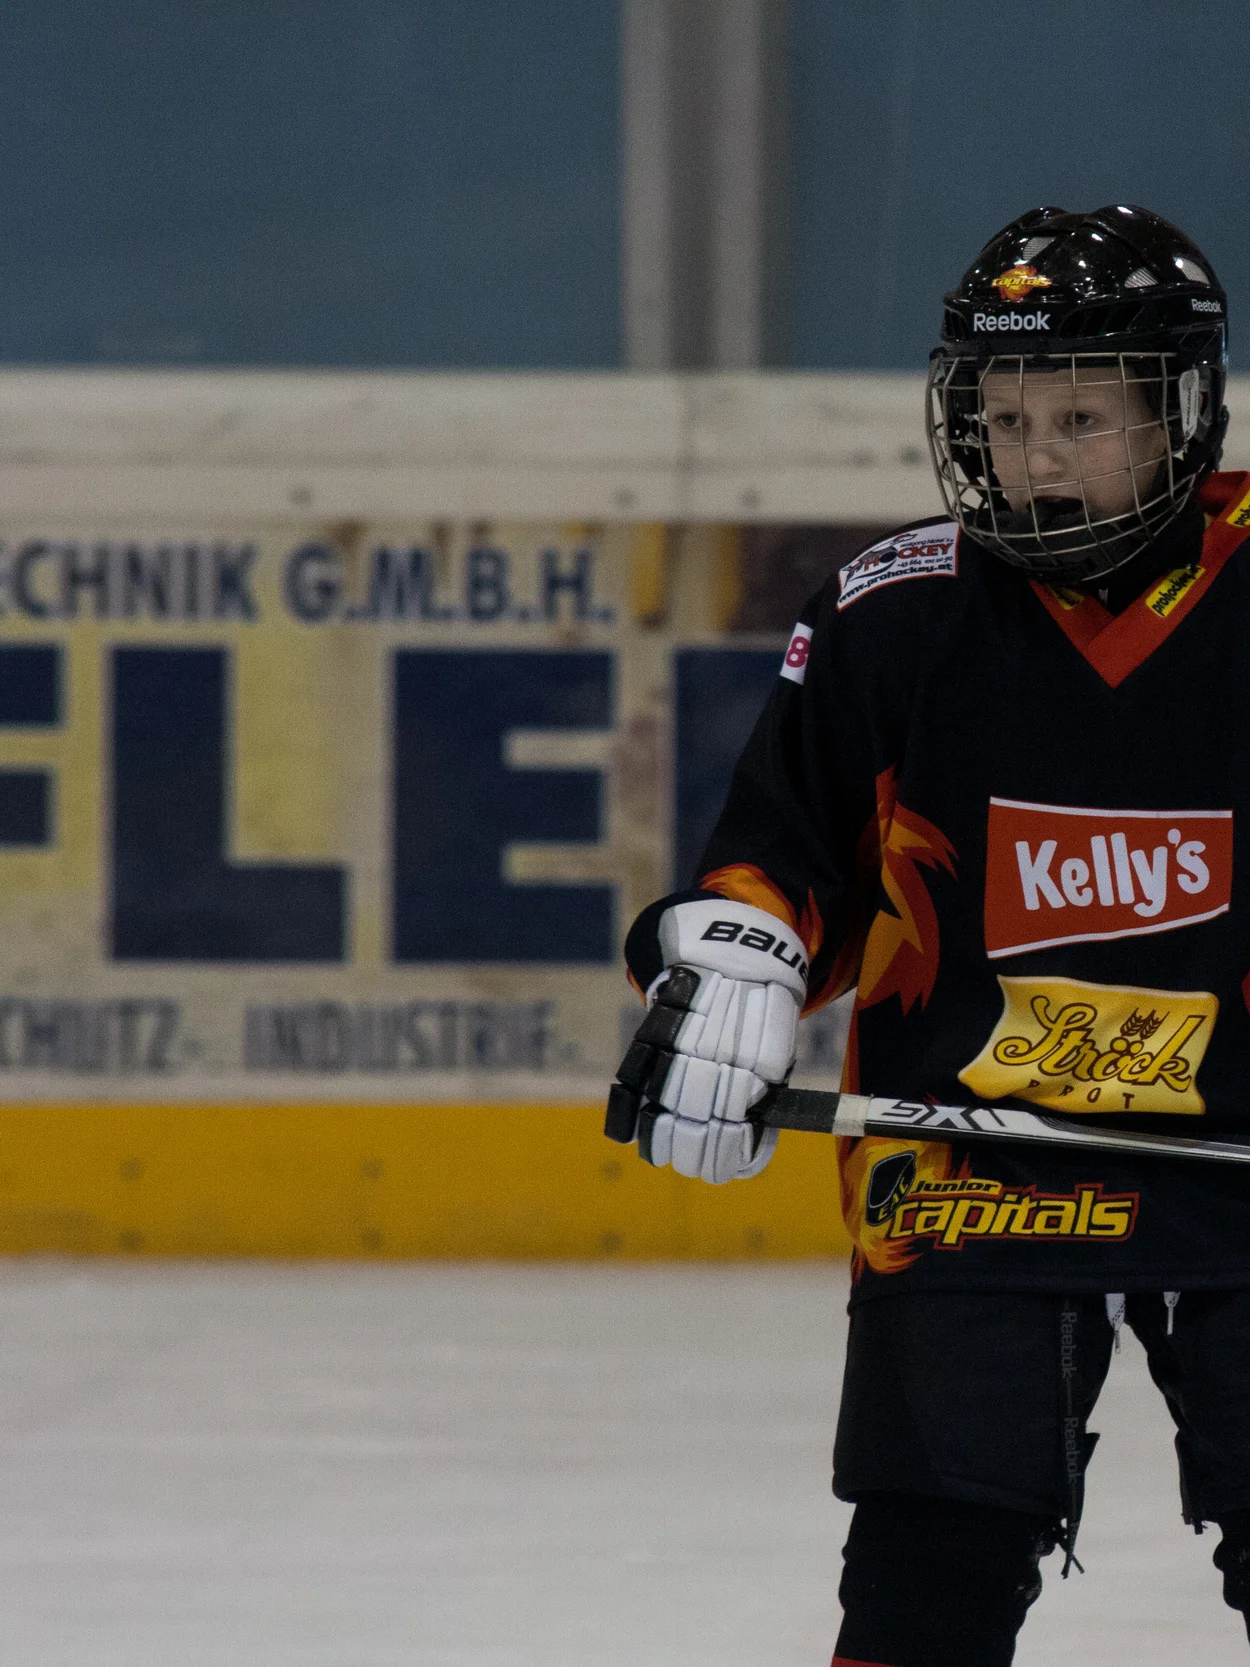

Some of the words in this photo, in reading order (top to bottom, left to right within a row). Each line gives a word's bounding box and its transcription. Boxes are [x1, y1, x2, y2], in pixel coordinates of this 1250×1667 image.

[973, 311, 1051, 332] Reebok
[1191, 299, 1222, 314] Reebok
[0, 541, 260, 622] CHNIK
[1015, 828, 1210, 918] Kelly's
[993, 995, 1207, 1093] Ströck
[890, 1188, 1133, 1246] capitals
[1061, 1311, 1077, 1380] Reebok
[1064, 1416, 1081, 1485] Reebok
